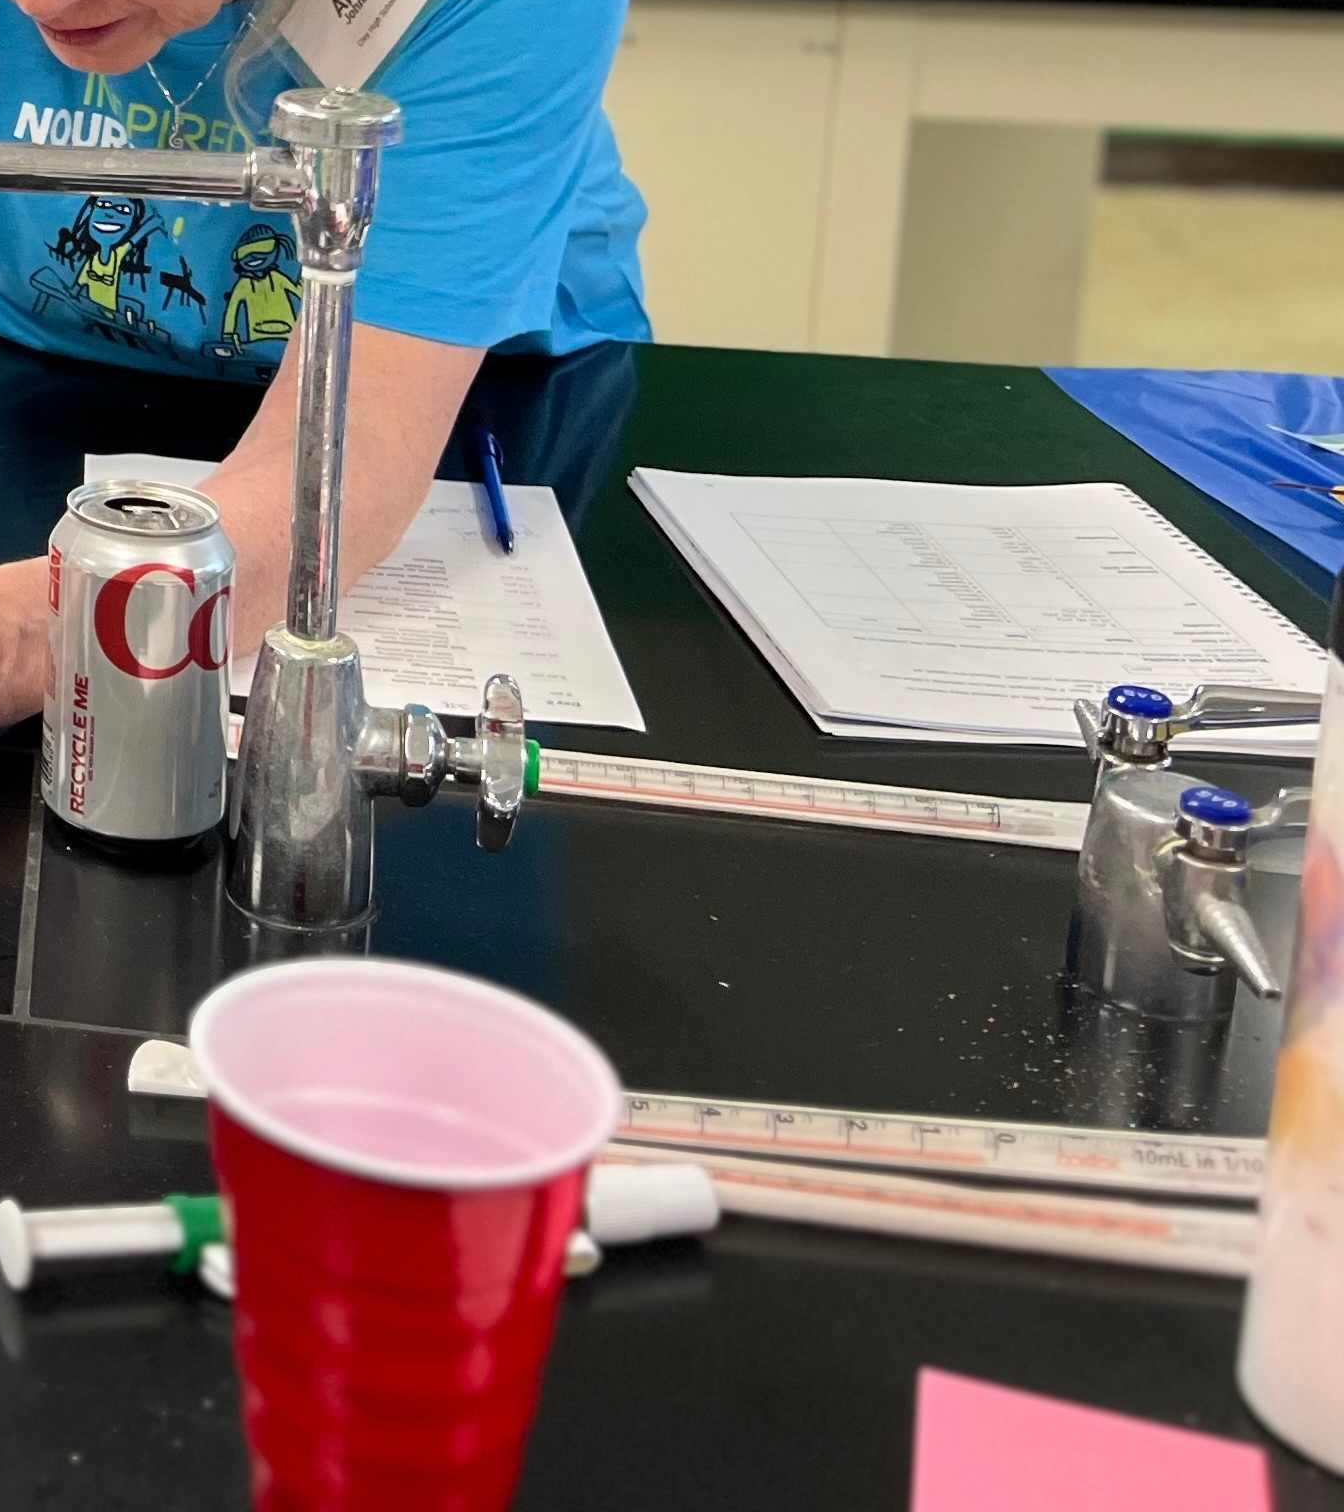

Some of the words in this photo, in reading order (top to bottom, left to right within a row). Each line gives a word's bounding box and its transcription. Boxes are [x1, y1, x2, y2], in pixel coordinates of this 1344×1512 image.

[75, 672, 88, 711] ME
[1123, 688, 1162, 702] GAS
[70, 712, 87, 815] RECYCLE
[1195, 790, 1239, 809] GAS
[1134, 1149, 1189, 1167] 10mL
[1196, 1154, 1217, 1169] in
